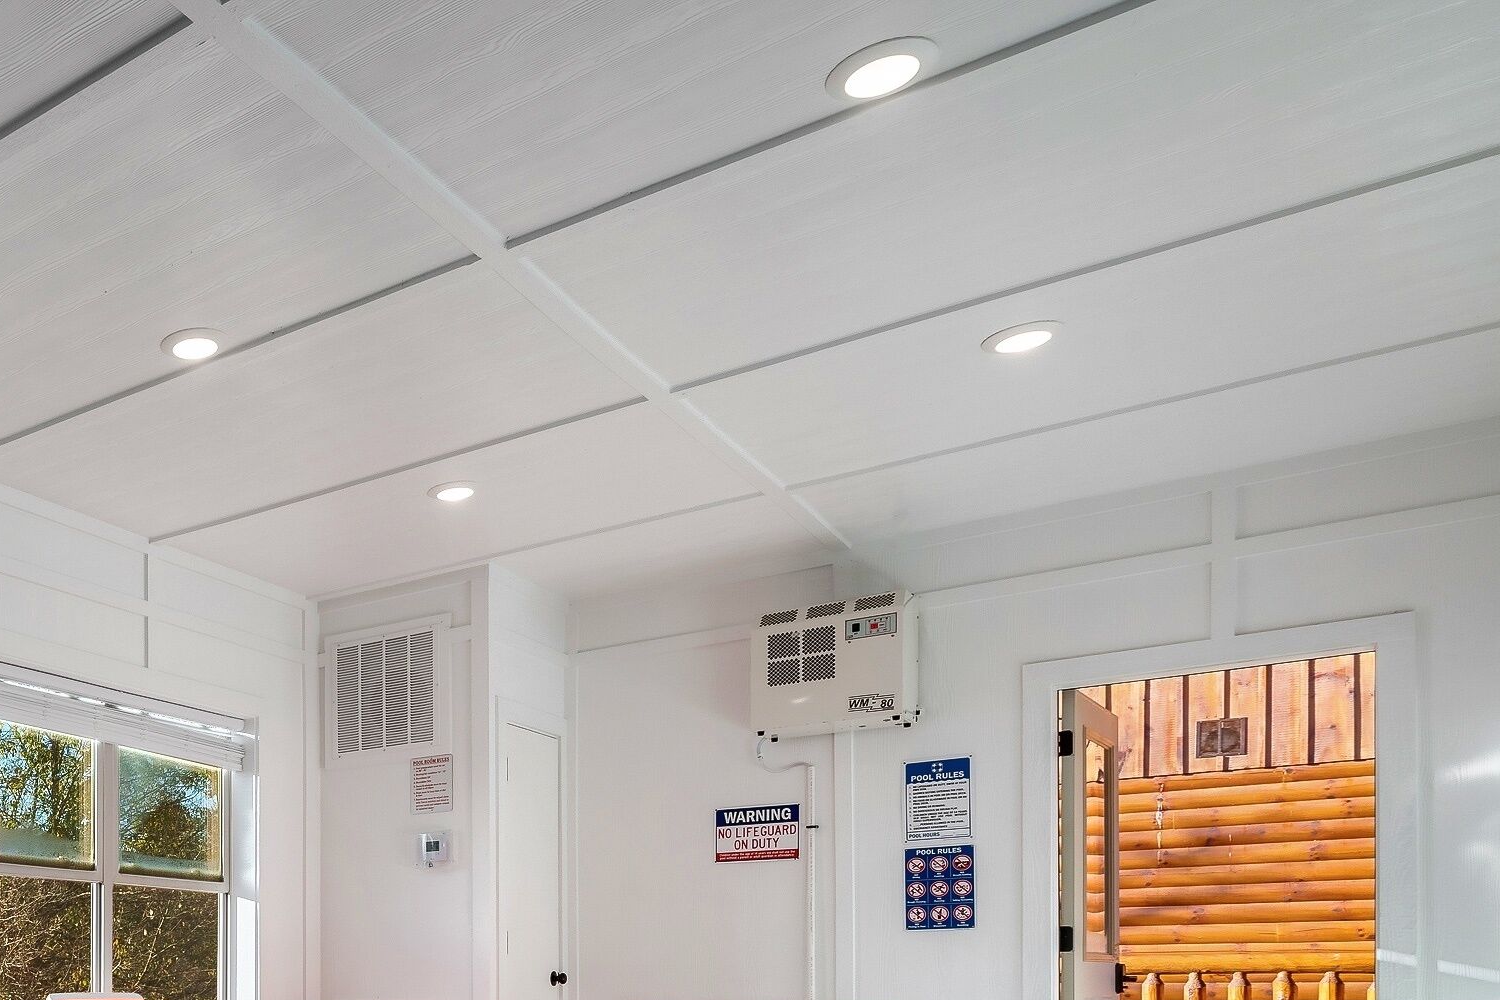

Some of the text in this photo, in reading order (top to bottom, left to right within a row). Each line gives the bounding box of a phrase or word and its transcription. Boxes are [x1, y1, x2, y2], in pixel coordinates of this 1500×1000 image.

[910, 770, 965, 782] POOL RULES
[724, 808, 792, 824] WARNING
[718, 824, 797, 839] NO LIFEGUARD
[734, 838, 779, 850] ON DUTY
